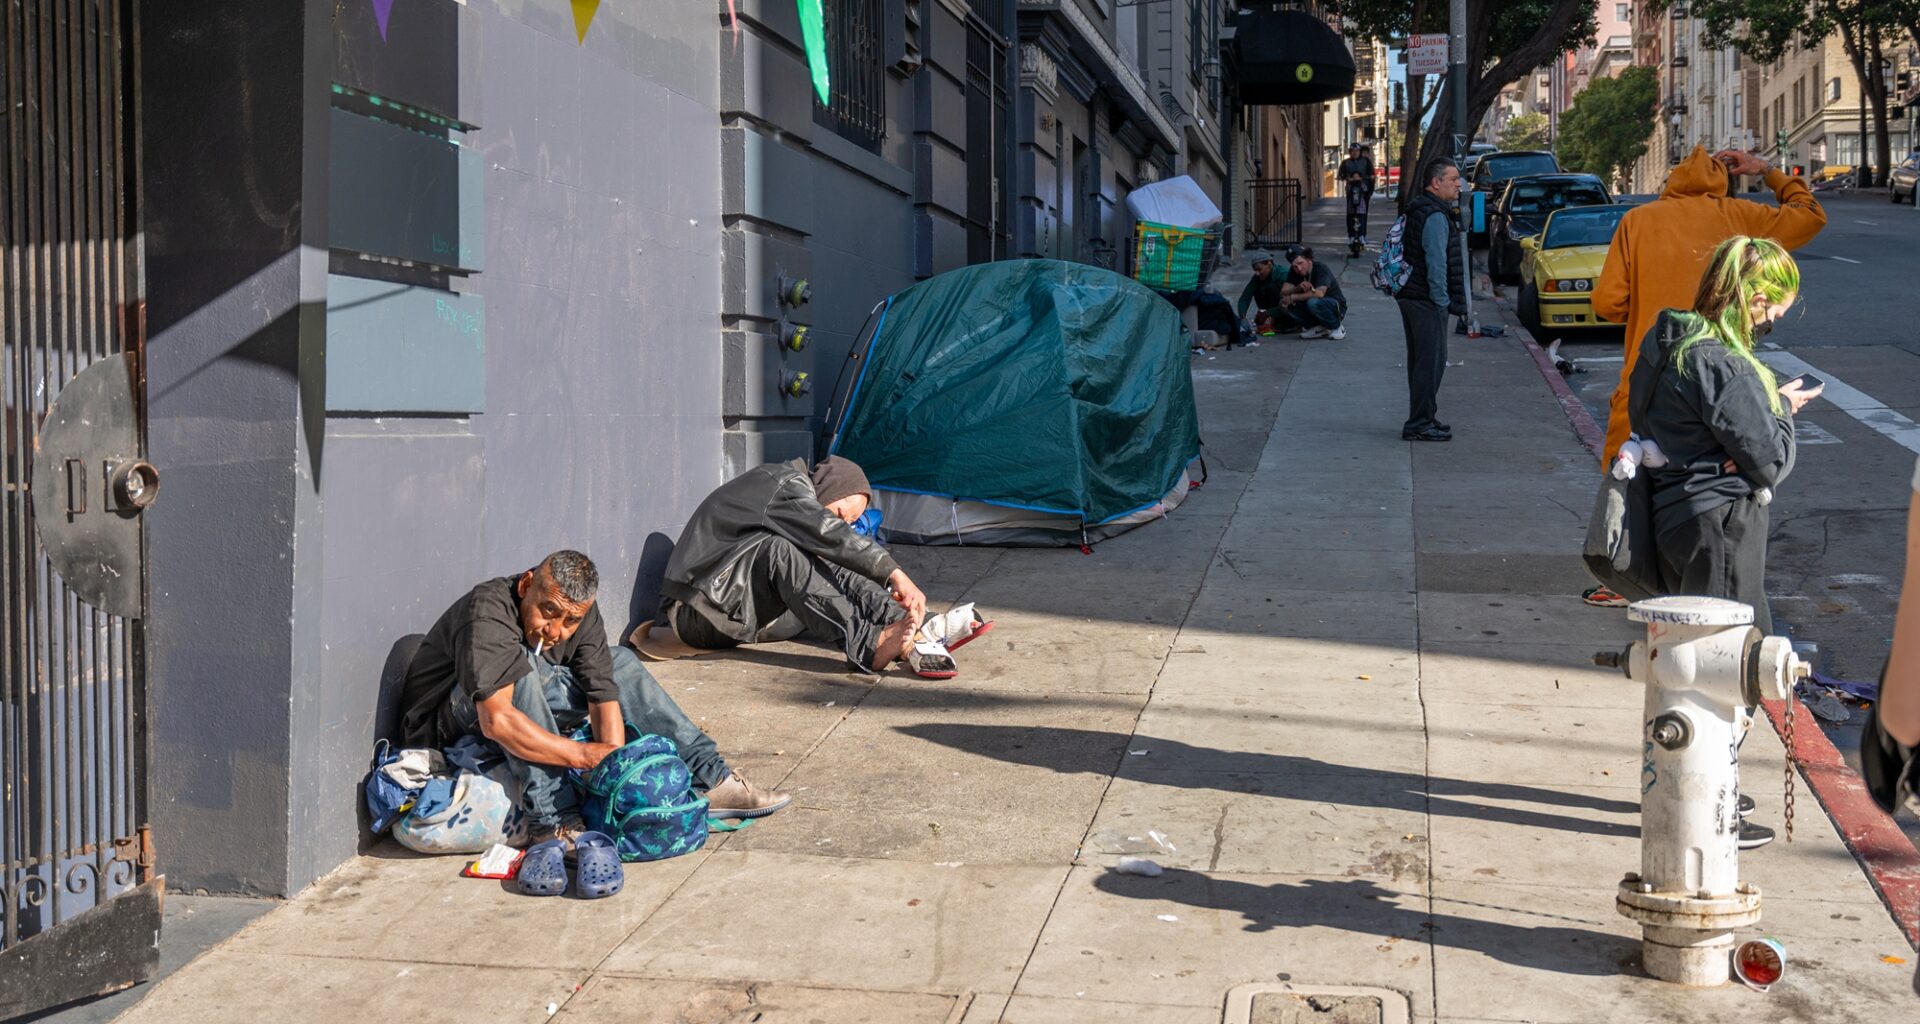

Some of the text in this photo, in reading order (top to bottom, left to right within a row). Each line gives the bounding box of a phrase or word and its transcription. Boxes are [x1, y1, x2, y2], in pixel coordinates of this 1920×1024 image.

[1409, 37, 1447, 47] NO PARKING
[1415, 59, 1441, 67] TUESDAY
